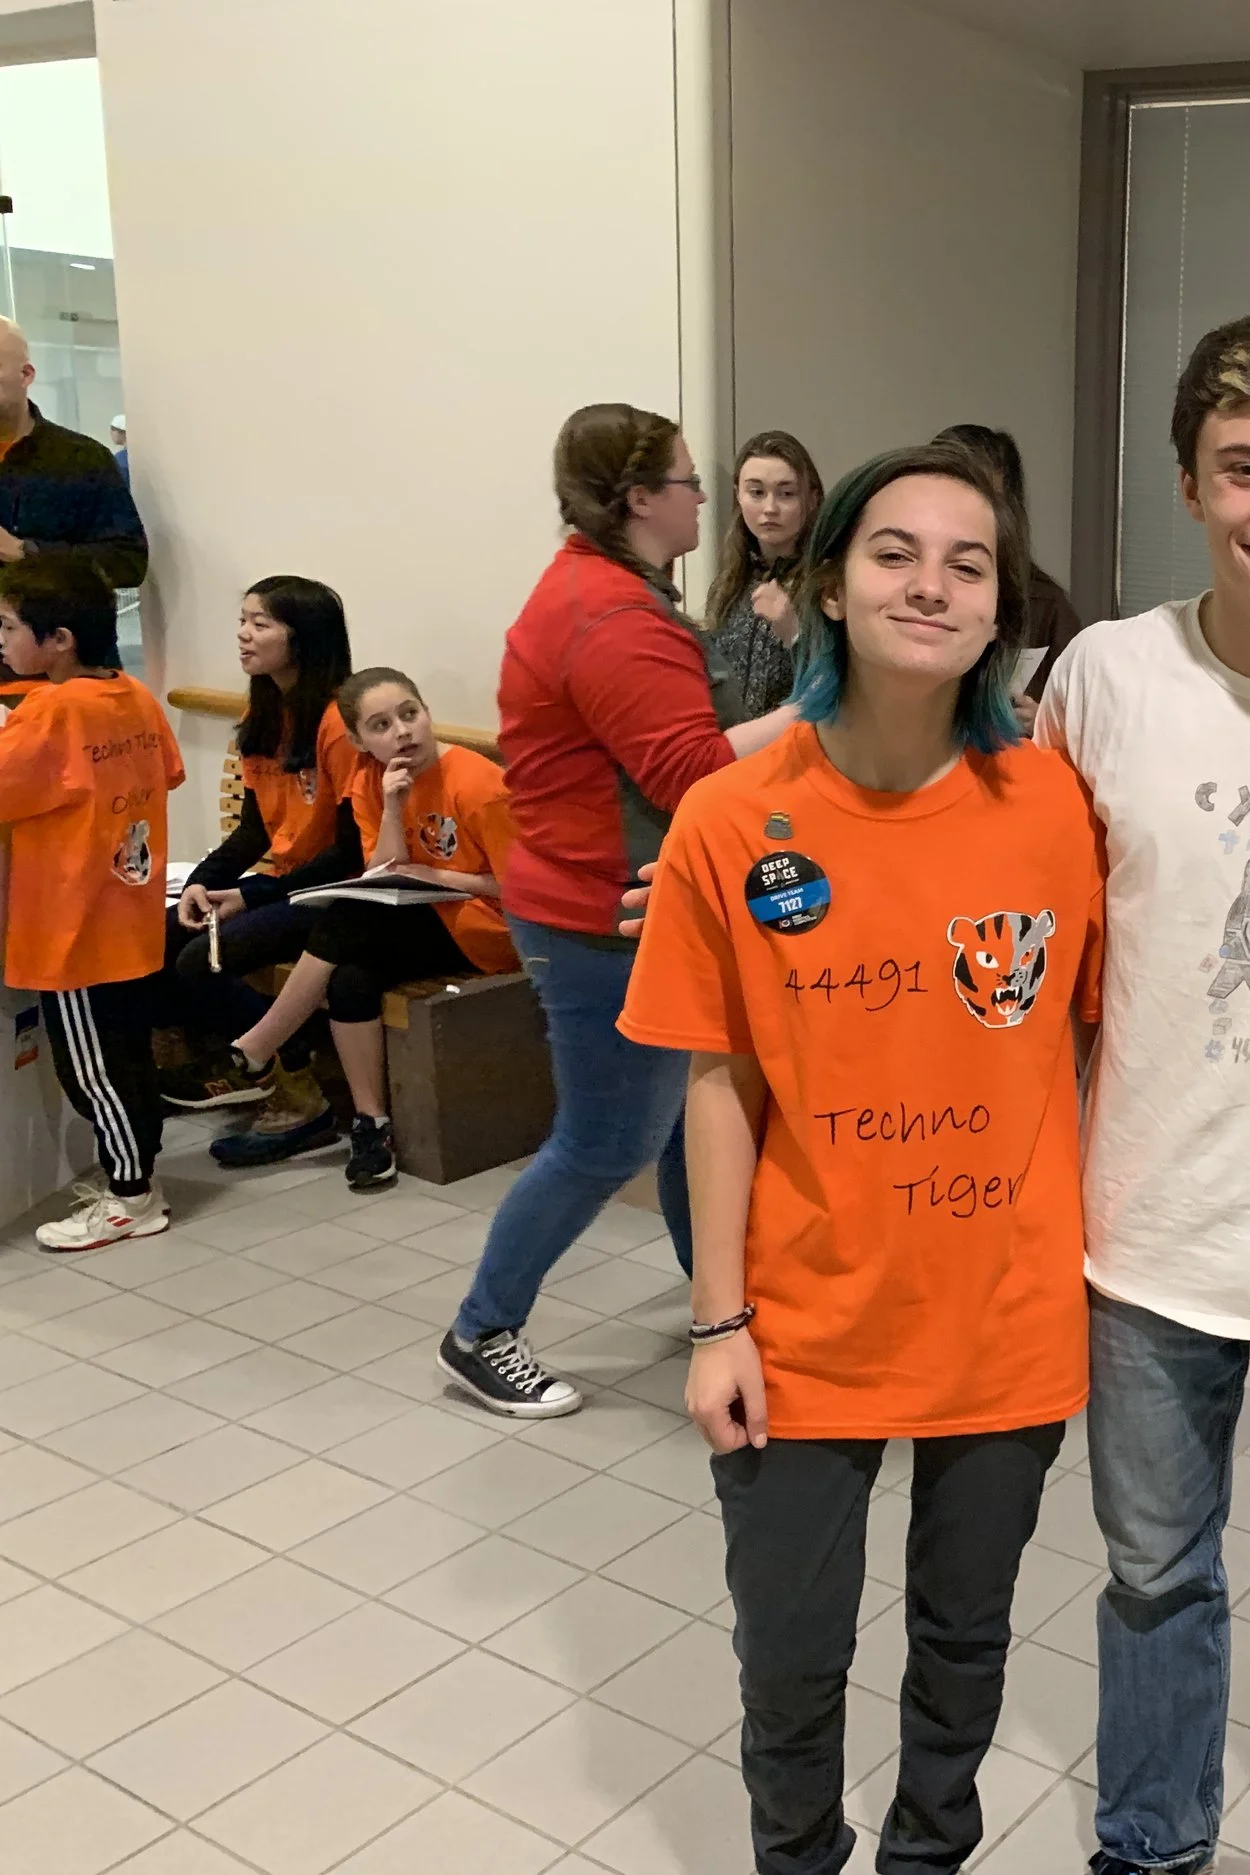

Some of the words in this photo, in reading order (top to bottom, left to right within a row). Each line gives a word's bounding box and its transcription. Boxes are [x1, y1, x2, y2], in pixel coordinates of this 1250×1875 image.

[761, 857, 790, 874] DEEP
[761, 866, 799, 887] SPACE
[788, 887, 804, 896] TEAM
[778, 896, 803, 914] 7127
[785, 958, 929, 1011] 44491
[814, 1101, 991, 1145] Techno
[893, 1165, 1024, 1218] Tiger
